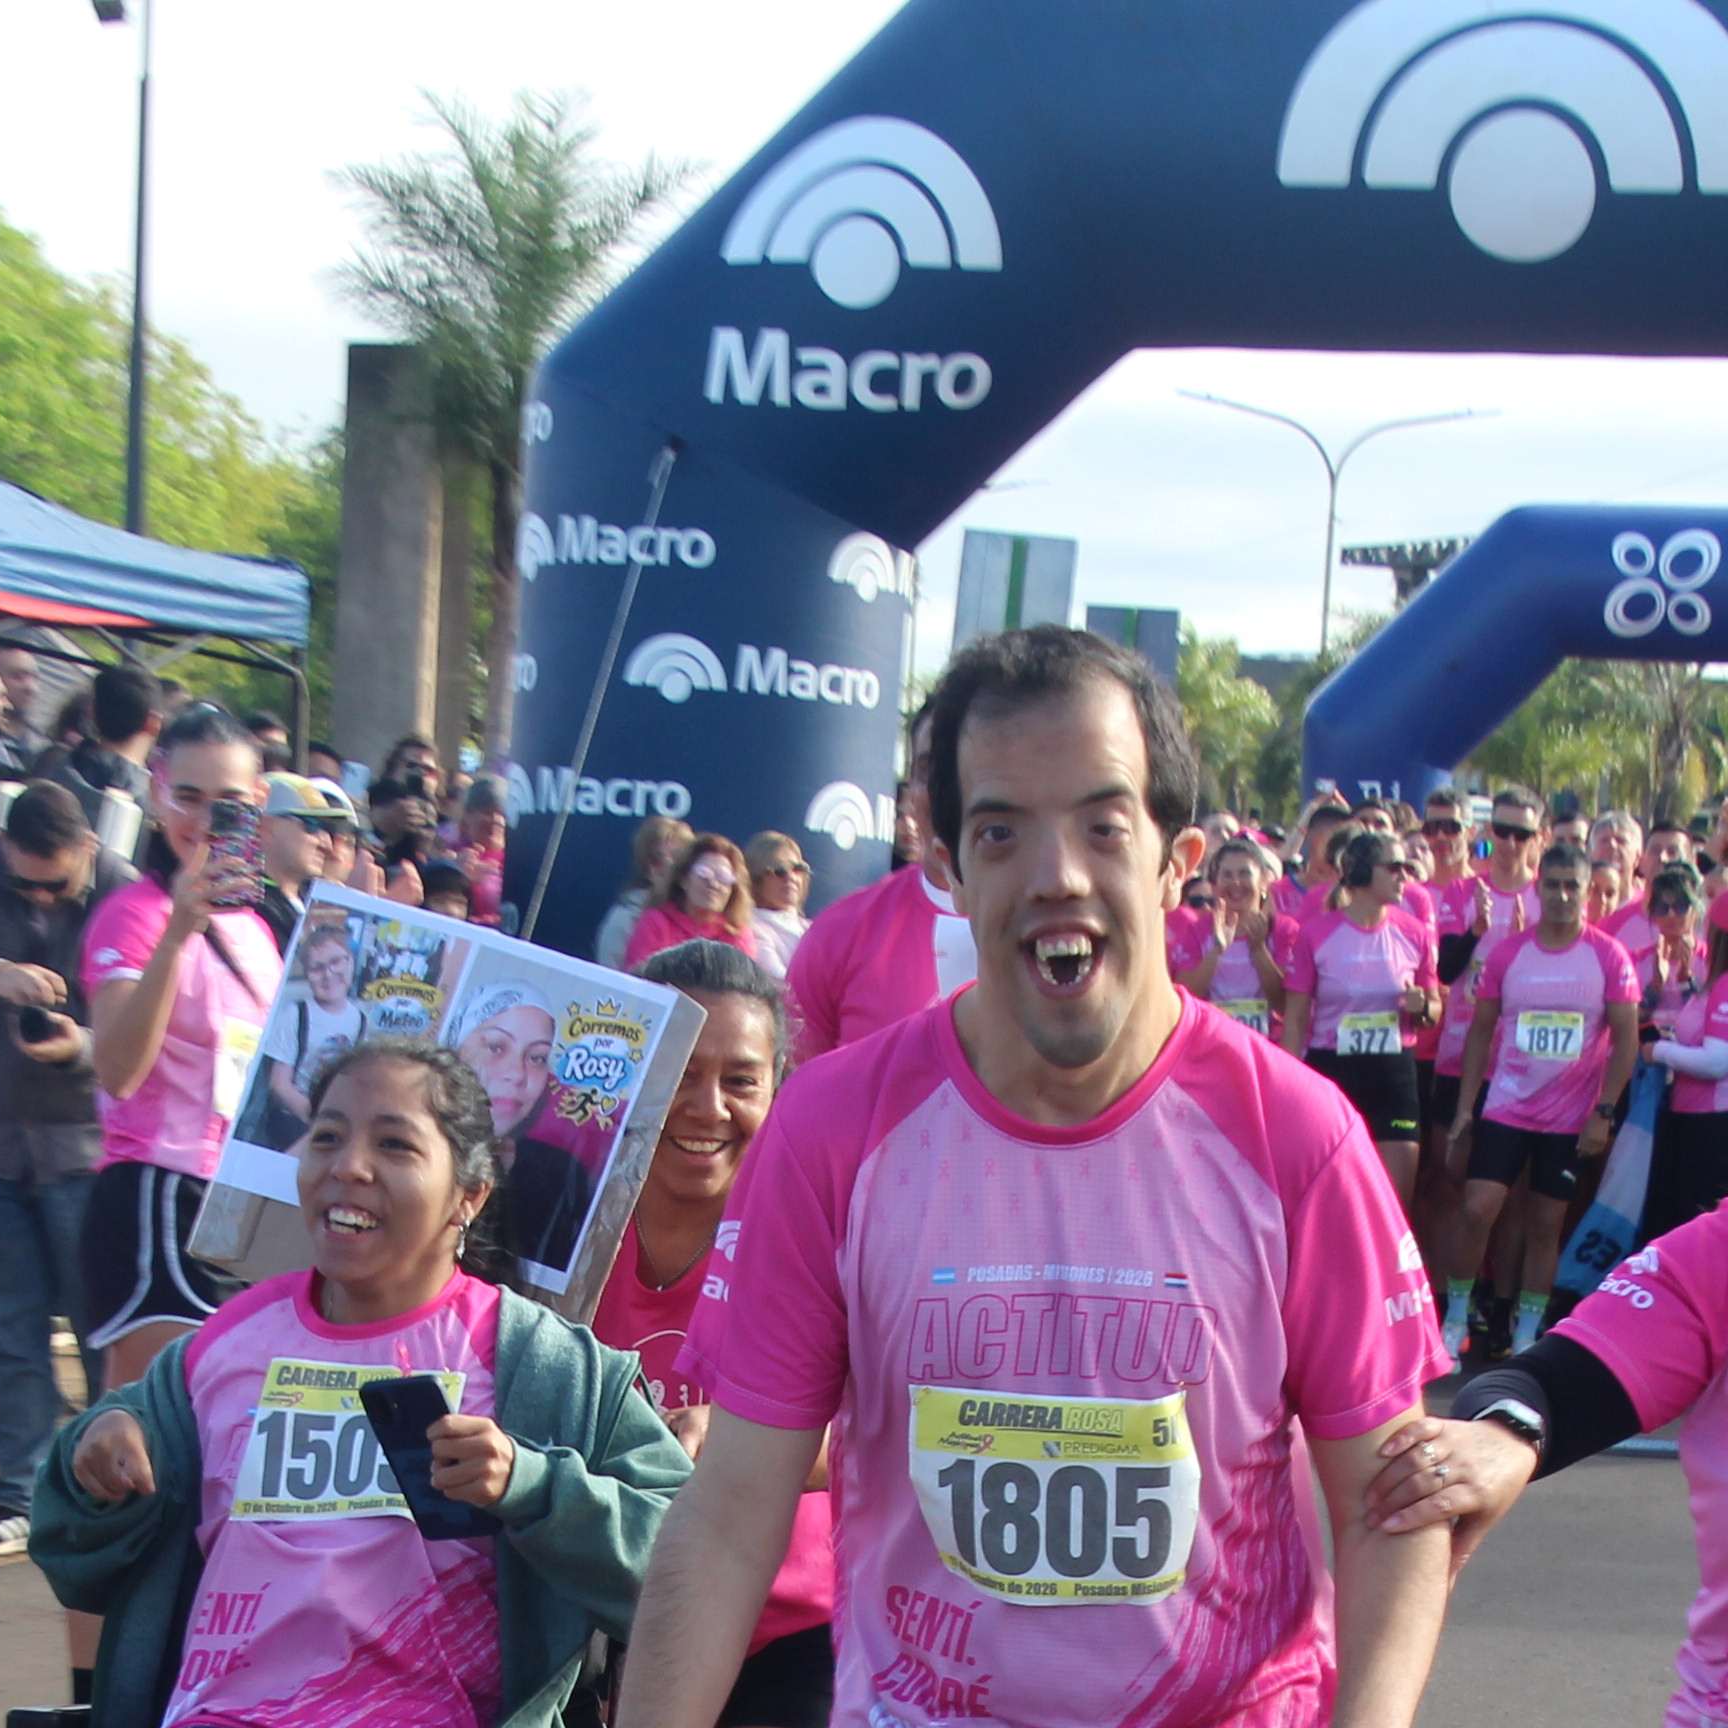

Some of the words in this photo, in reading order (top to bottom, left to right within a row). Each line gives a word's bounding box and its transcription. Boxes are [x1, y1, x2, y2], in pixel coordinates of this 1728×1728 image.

[703, 326, 992, 412] Macro
[557, 515, 716, 568] Macro
[733, 643, 880, 710] Macro
[535, 765, 692, 818] Macro
[569, 1017, 641, 1041] Corremos
[593, 1038, 615, 1052] por
[1528, 1027, 1574, 1053] 1817
[564, 1046, 626, 1091] Rosy
[967, 1264, 1033, 1283] POSADAS
[1598, 1273, 1654, 1309] acro
[906, 1292, 1220, 1387] ACTITUD
[277, 1365, 358, 1388] CARRERA
[959, 1400, 1064, 1430] CARRERA
[1065, 1407, 1123, 1433] ROSA
[257, 1410, 404, 1501] 150
[938, 1457, 1172, 1579] 1805
[1024, 1583, 1057, 1596] 2026
[1074, 1583, 1128, 1597] Posadas
